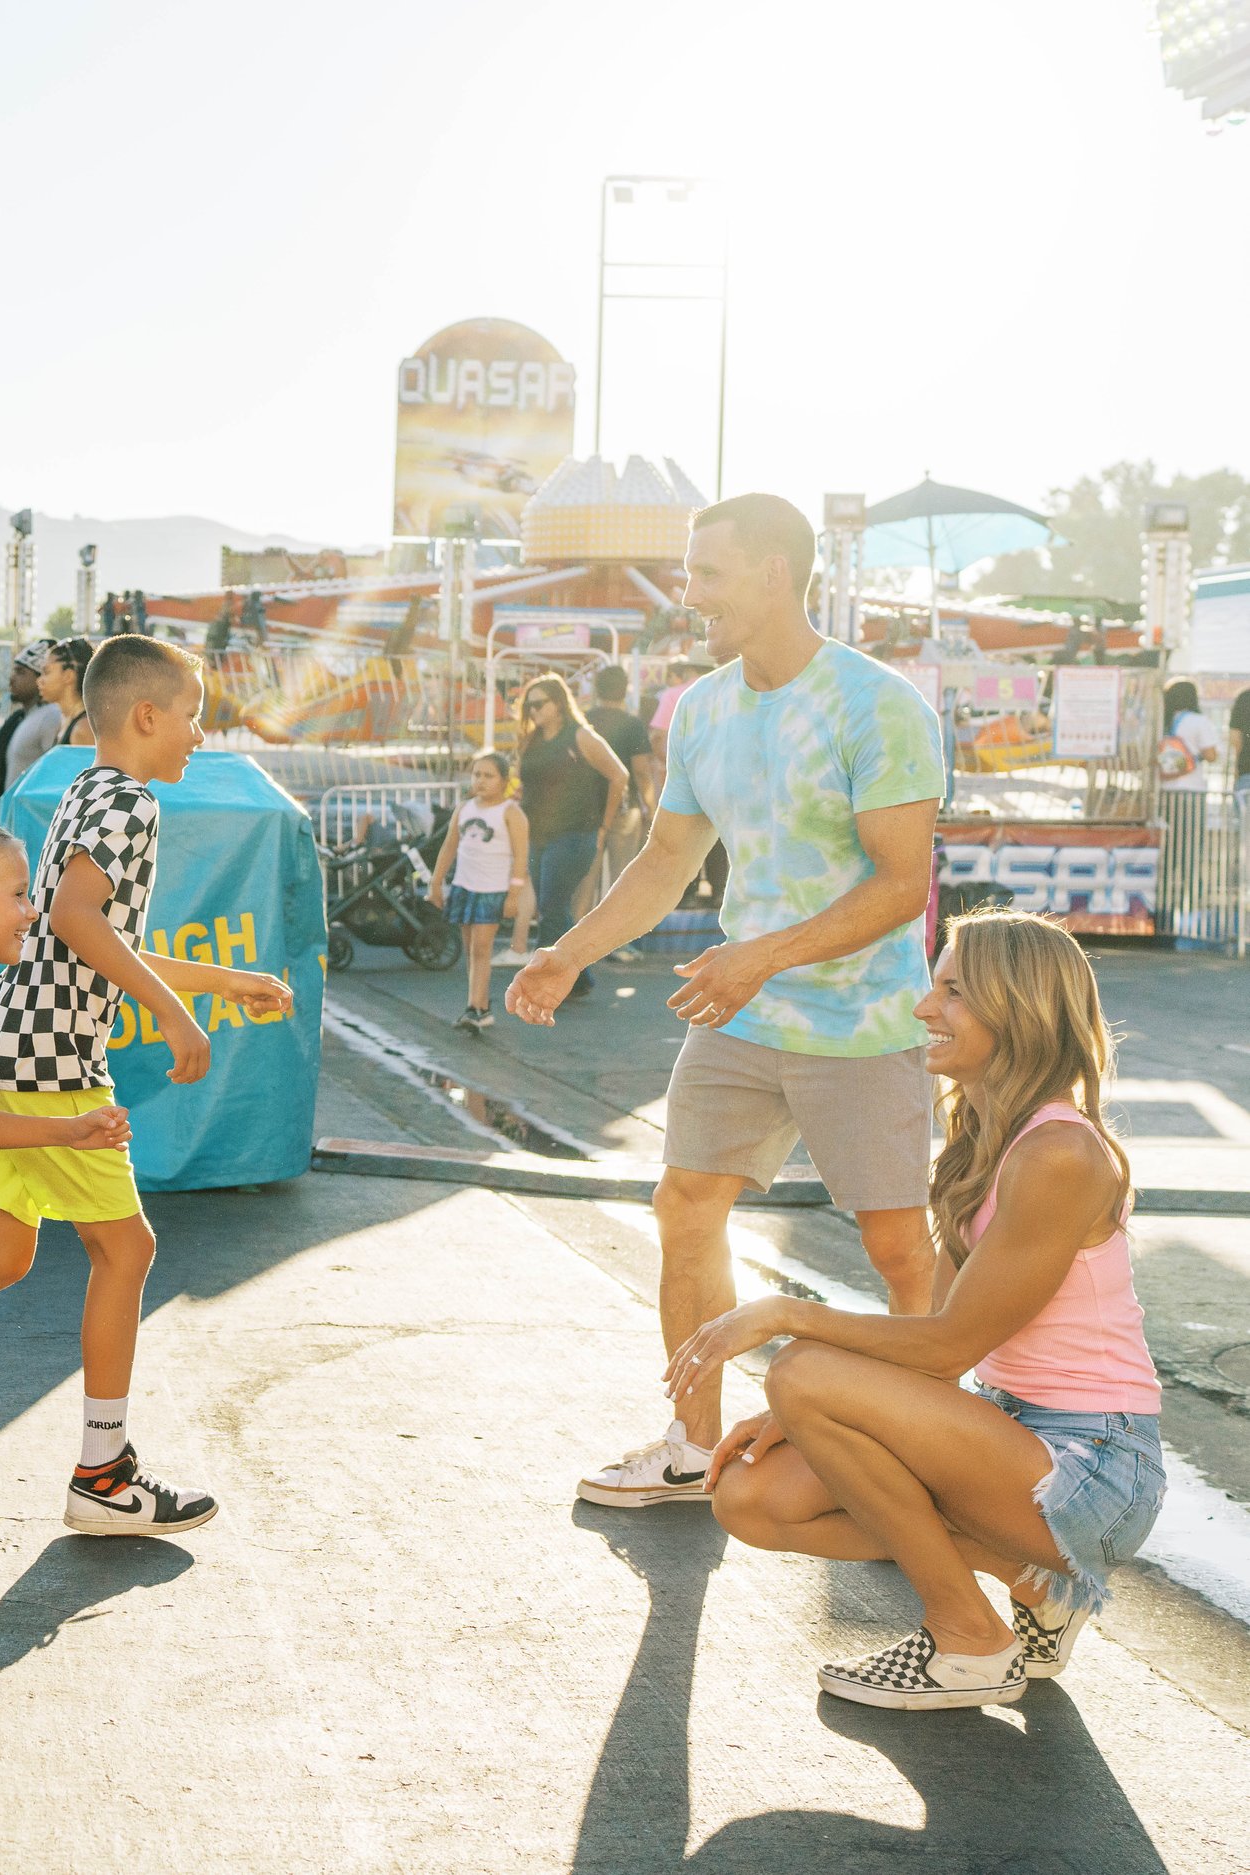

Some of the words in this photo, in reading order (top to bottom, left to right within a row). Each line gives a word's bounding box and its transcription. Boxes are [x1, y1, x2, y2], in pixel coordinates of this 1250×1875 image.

[399, 352, 576, 414] QUASAR
[141, 912, 257, 968] IGH
[86, 1419, 123, 1430] JORDAN
